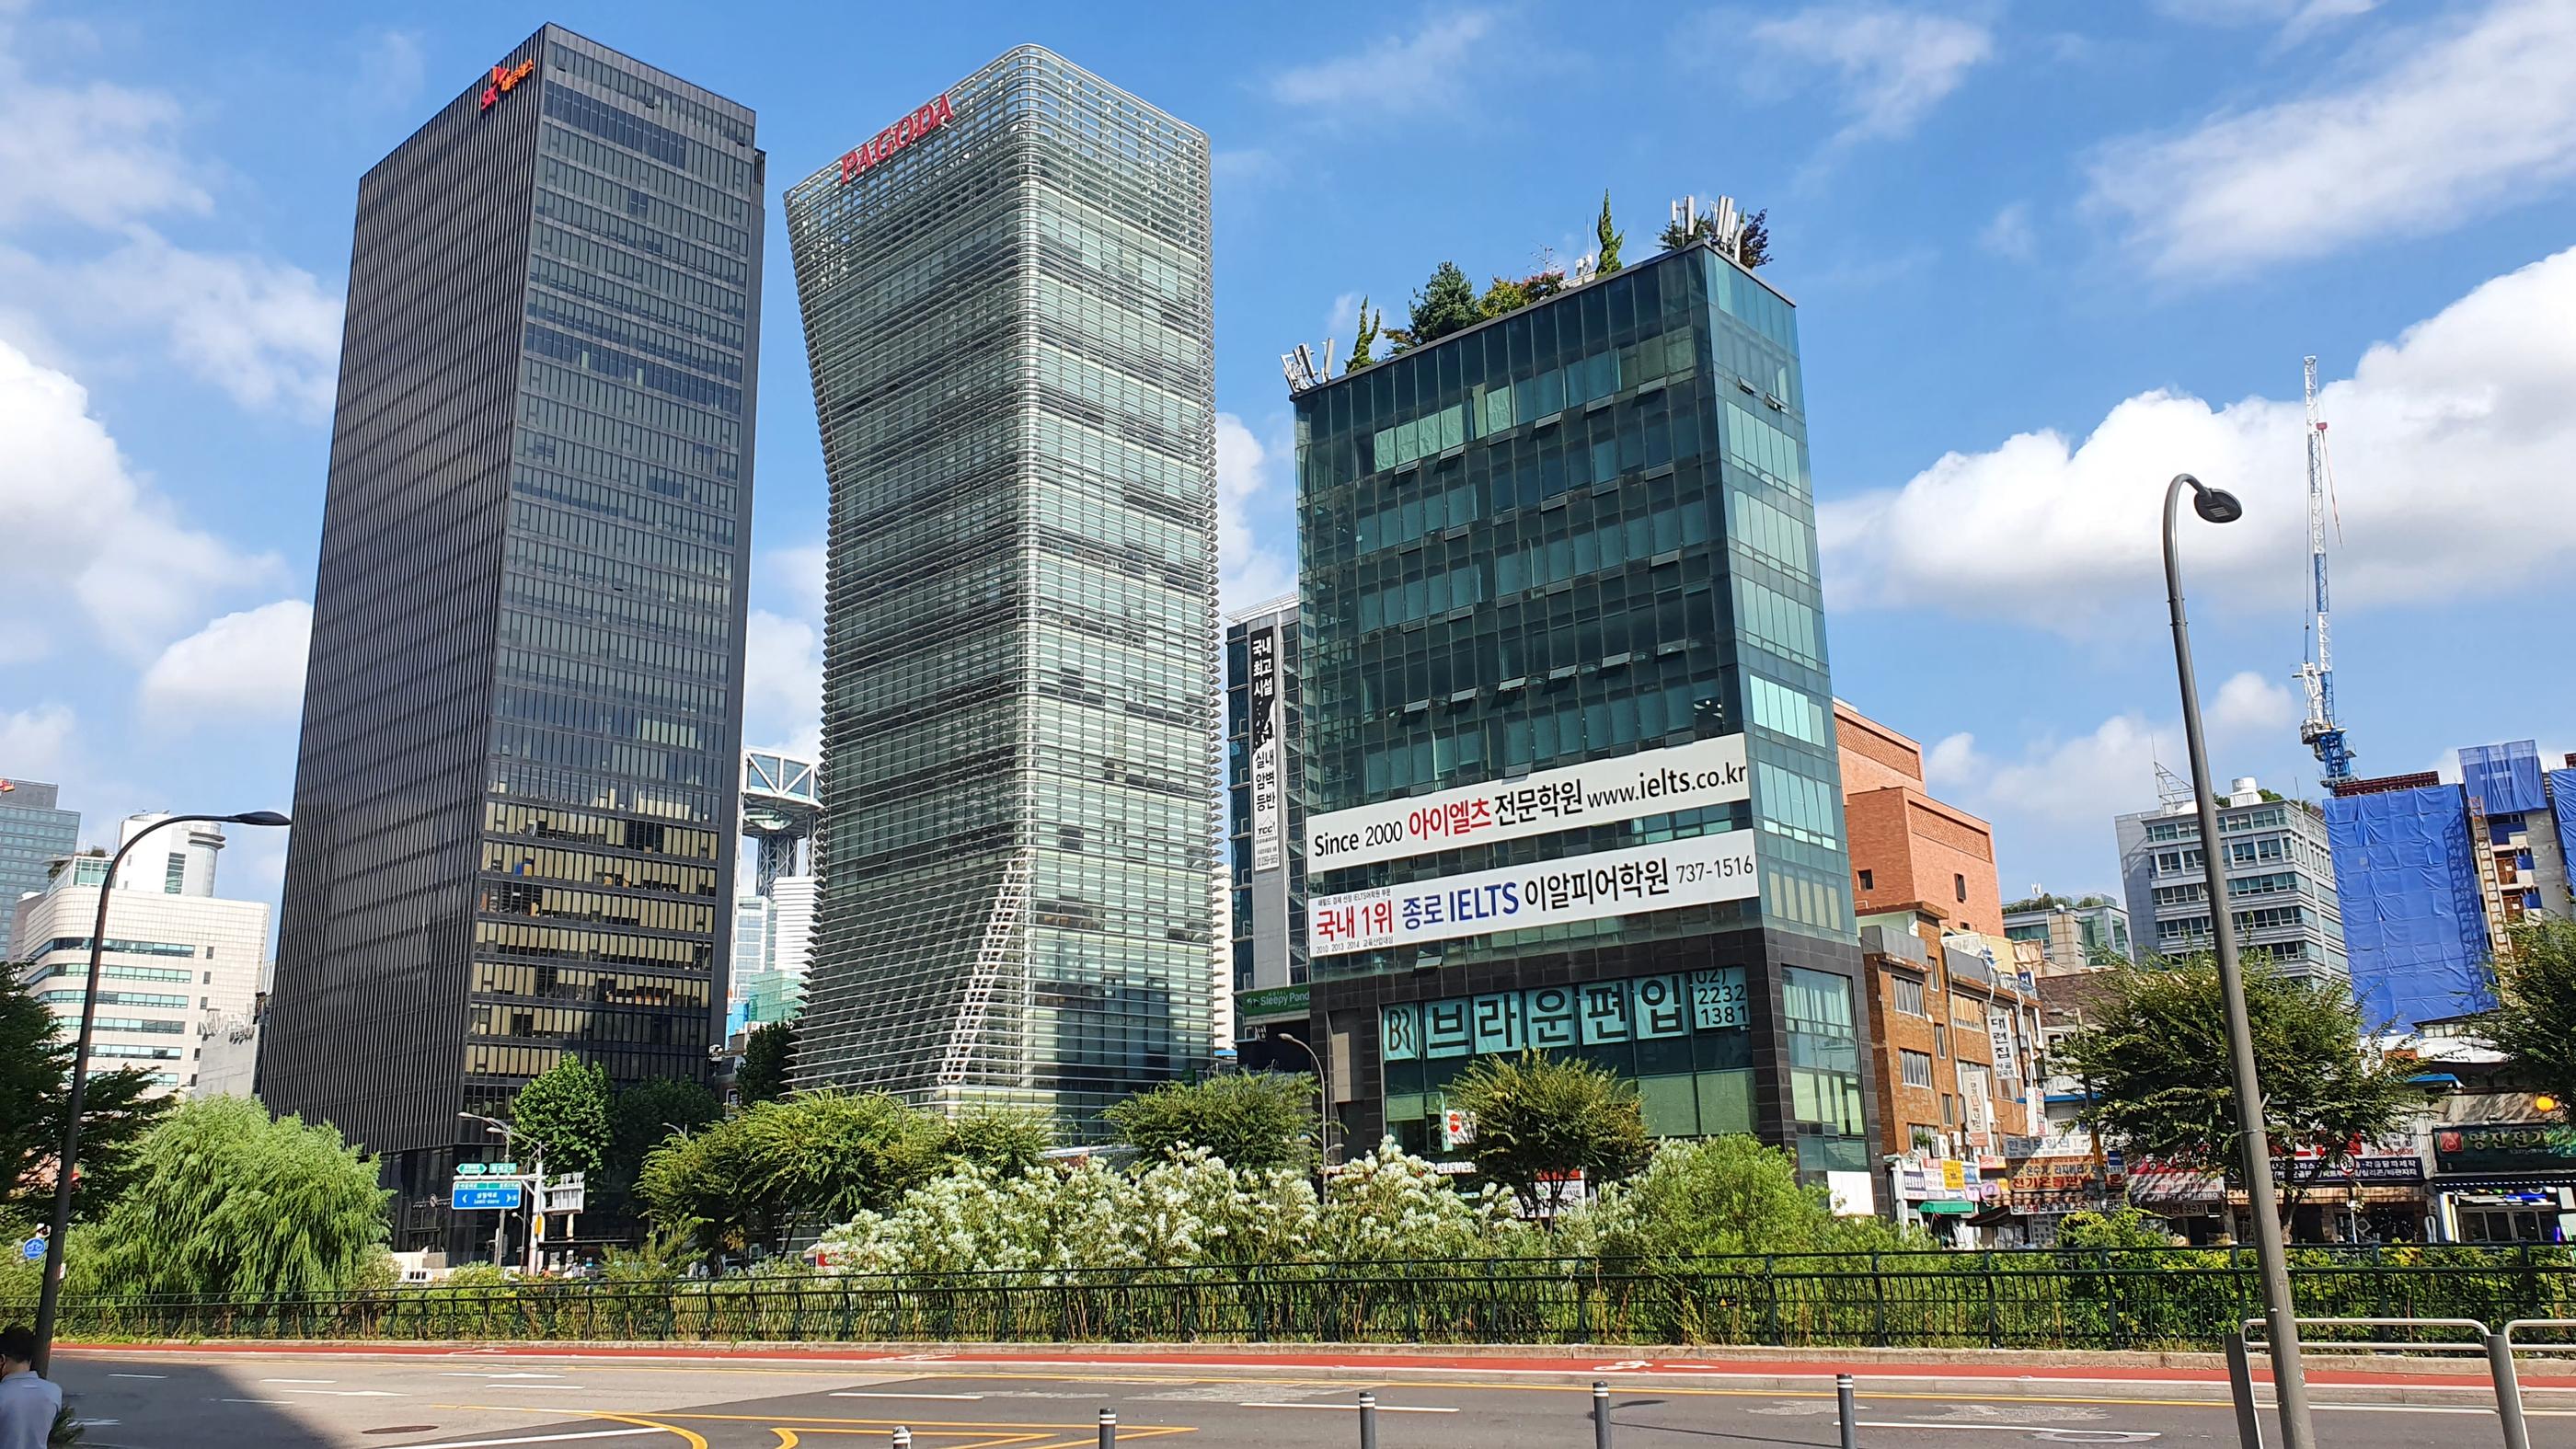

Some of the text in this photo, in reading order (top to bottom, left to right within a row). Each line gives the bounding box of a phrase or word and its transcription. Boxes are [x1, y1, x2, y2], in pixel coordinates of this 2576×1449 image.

[841, 93, 955, 185] PAGODA
[1252, 636, 1271, 656] 국내
[1253, 659, 1273, 676] 최고
[1253, 677, 1273, 697] 시설
[1255, 750, 1274, 769] 실내
[1256, 770, 1275, 790] 암벽
[1257, 791, 1275, 811] 등반
[1315, 762, 1746, 857] Since 2000 아이엘츠 전문학원 www.ielts.co.kr
[1258, 826, 1273, 835] TCC
[1402, 856, 1754, 929] 종로 IELTS 이알피어학원 737-1516
[1317, 900, 1393, 942] 국내 1위
[1332, 942, 1344, 951] 2013
[1347, 940, 1360, 949] 2014
[1260, 995, 1289, 1007] Sleepy
[1290, 990, 1310, 1002] Pand
[1697, 983, 1746, 1005] 2232
[1428, 975, 1684, 1050] 브라운편입
[1700, 1005, 1746, 1026] 1381
